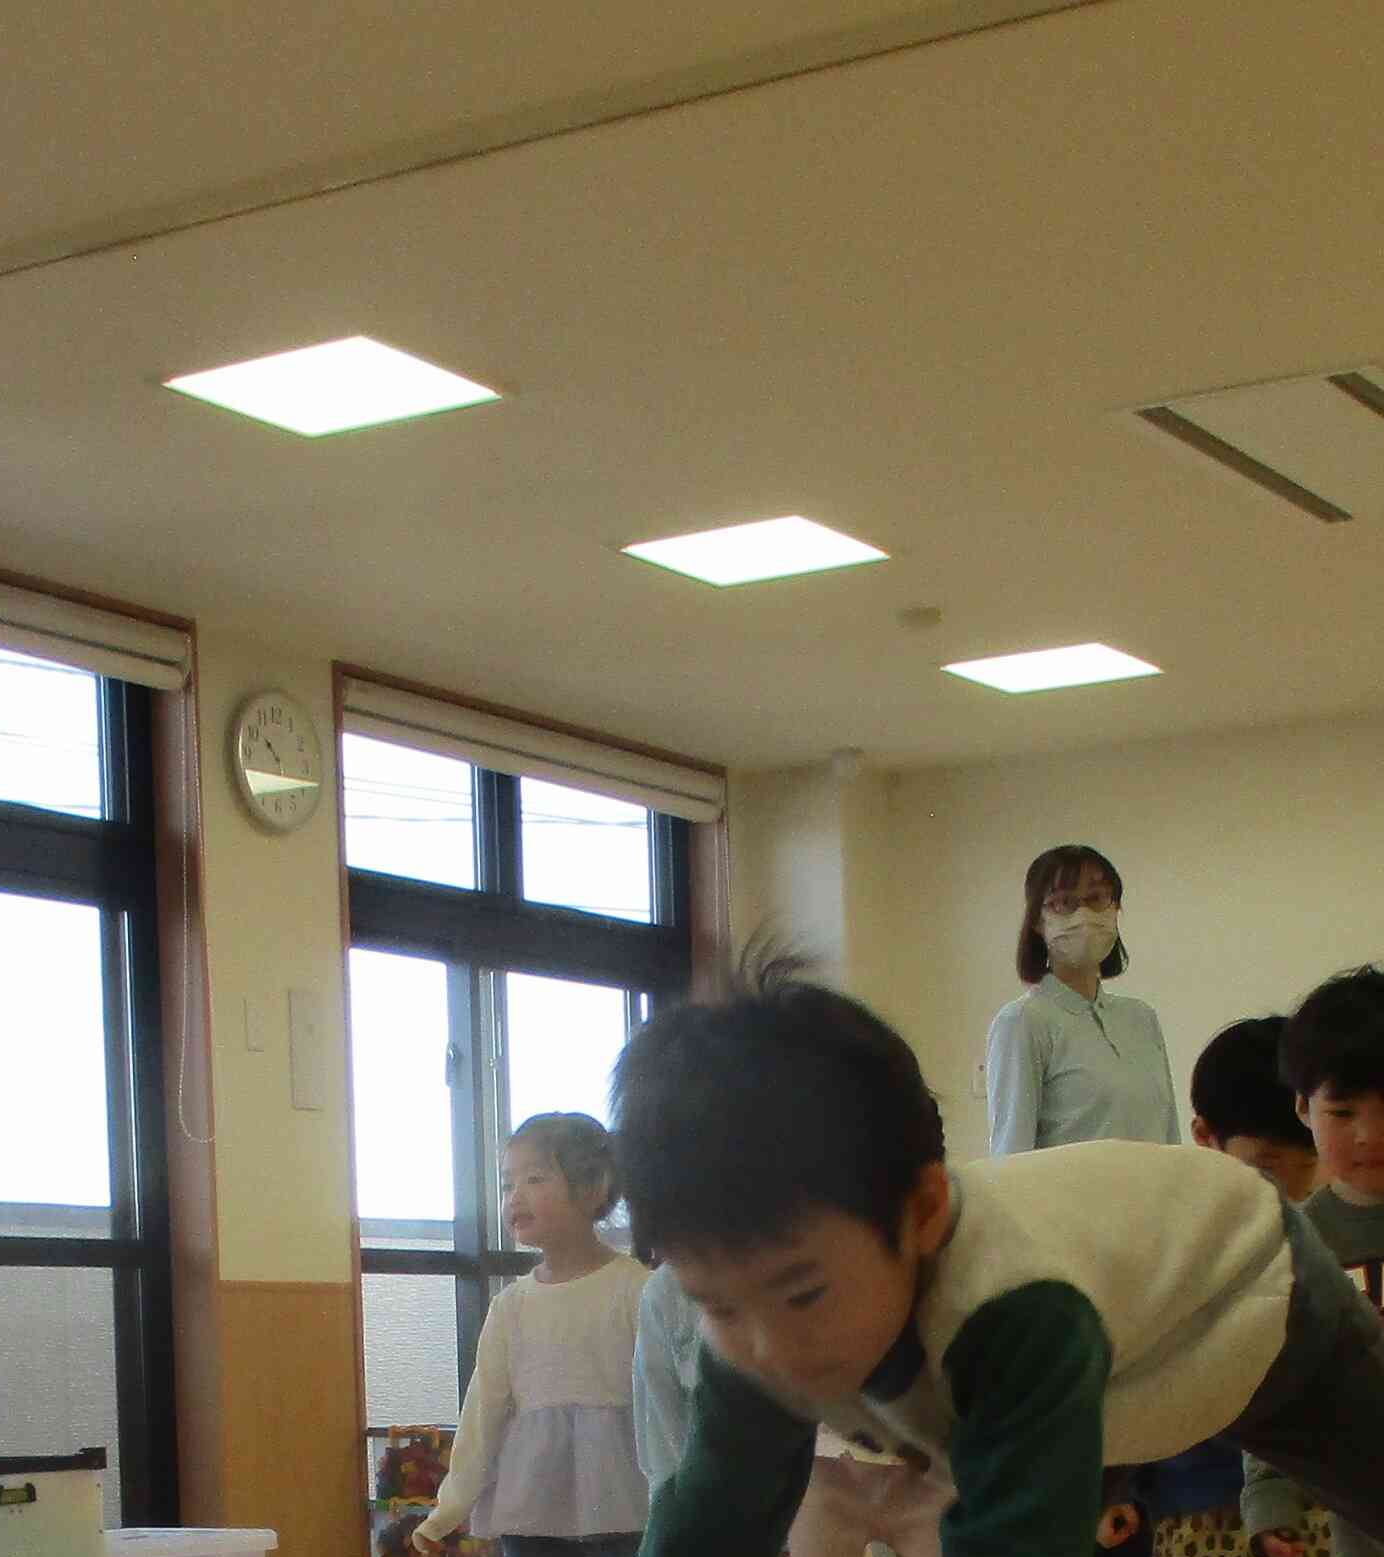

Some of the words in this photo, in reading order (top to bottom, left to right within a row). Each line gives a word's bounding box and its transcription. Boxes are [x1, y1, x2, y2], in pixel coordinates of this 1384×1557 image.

[256, 707, 267, 727] 11
[271, 705, 282, 726] 12
[287, 716, 294, 733] 1
[247, 724, 259, 742] 10
